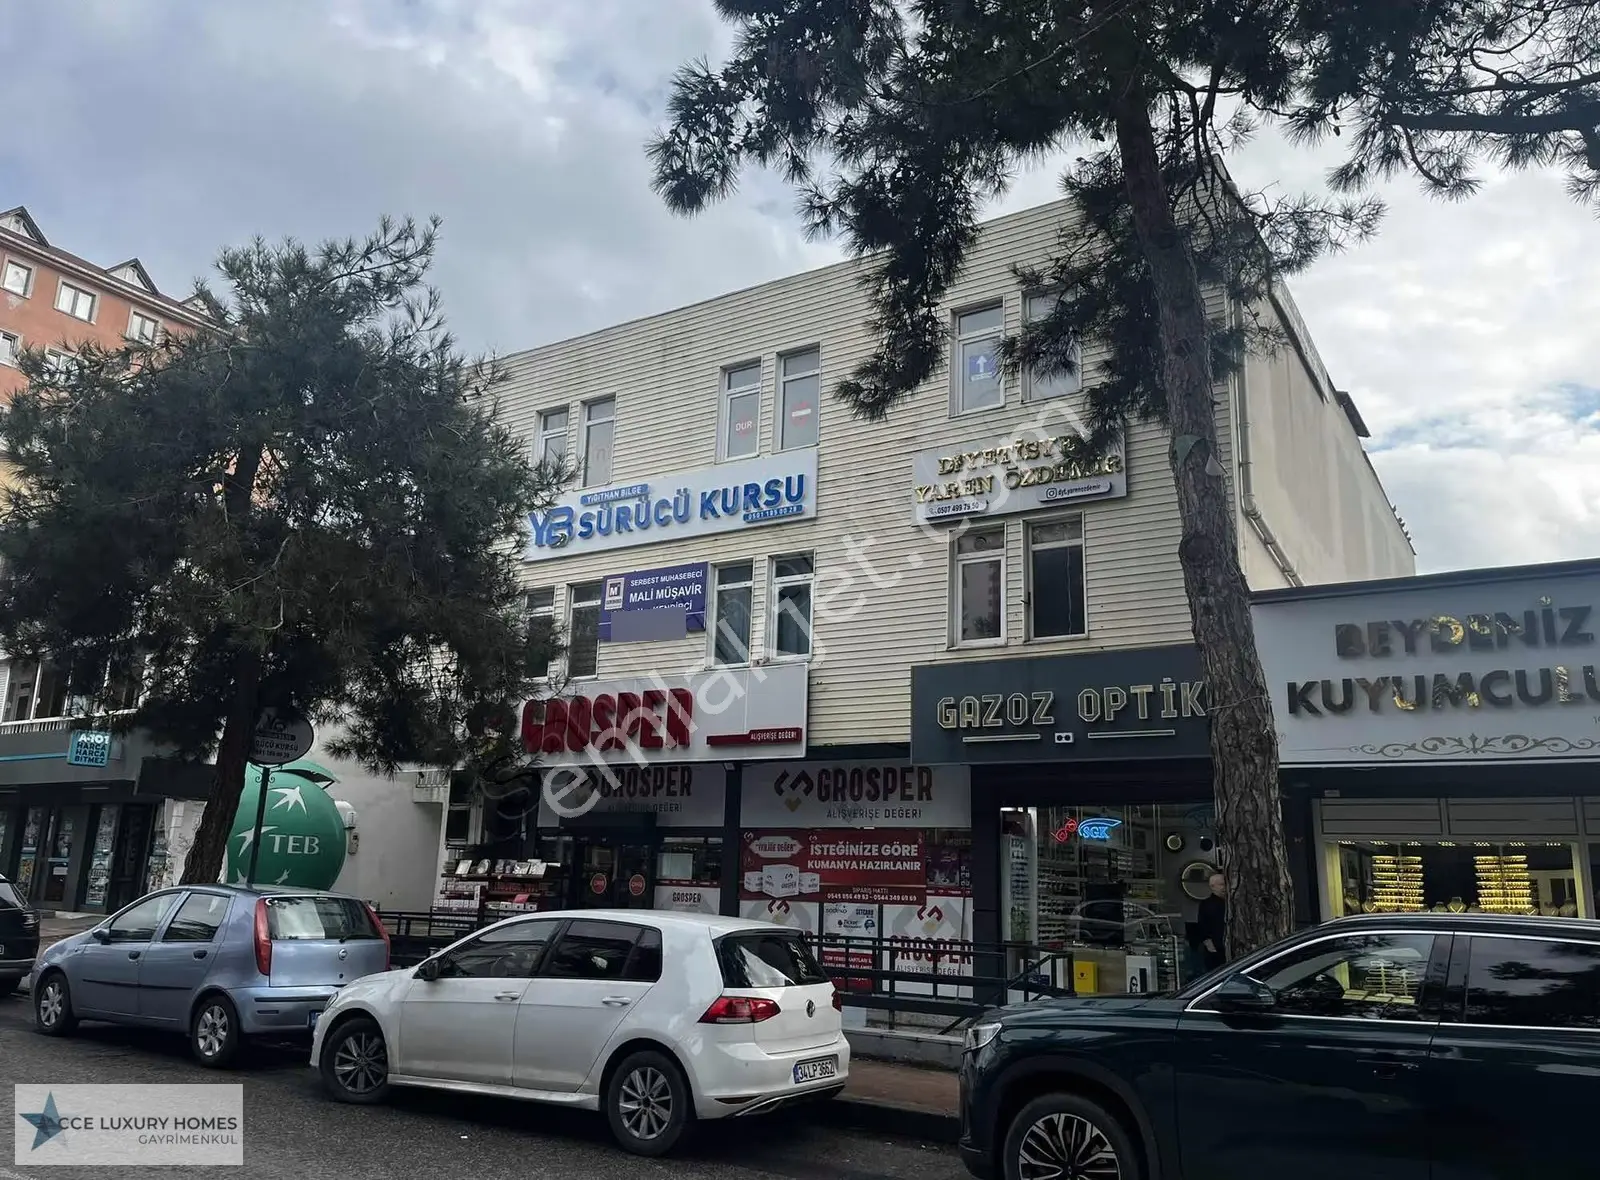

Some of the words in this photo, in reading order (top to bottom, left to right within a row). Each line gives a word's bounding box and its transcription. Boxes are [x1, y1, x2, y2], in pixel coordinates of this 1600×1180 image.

[735, 420, 753, 432] DUR
[620, 485, 642, 498] BİLGE
[916, 475, 994, 502] YAREN
[578, 488, 691, 540] SÜRÜCÜ
[700, 474, 805, 521] KURSU
[630, 577, 659, 587] SERBEST
[660, 570, 703, 582] MUHASEBECİ
[629, 588, 653, 603] MALİ
[656, 583, 702, 600] MÜŞAVİR
[1335, 595, 1594, 658] BEYDENİZ
[937, 691, 1054, 729] GAZOZ
[1077, 678, 1207, 722] OPTİK
[521, 688, 693, 753] GROSPER
[76, 749, 105, 757] HARCA
[817, 767, 933, 801] GROSPER
[827, 807, 880, 821] ALIŞVERİŞE
[1082, 826, 1110, 839] SGK
[268, 834, 320, 855] TEB
[810, 841, 879, 856] İSTEĞİNİZE
[881, 841, 919, 857] GÖRE
[807, 860, 858, 870] KUMANYA
[859, 860, 921, 871] HAZIRLANIR
[672, 892, 702, 903] GROSPER
[799, 1066, 808, 1080] 34
[808, 1064, 817, 1079] LP
